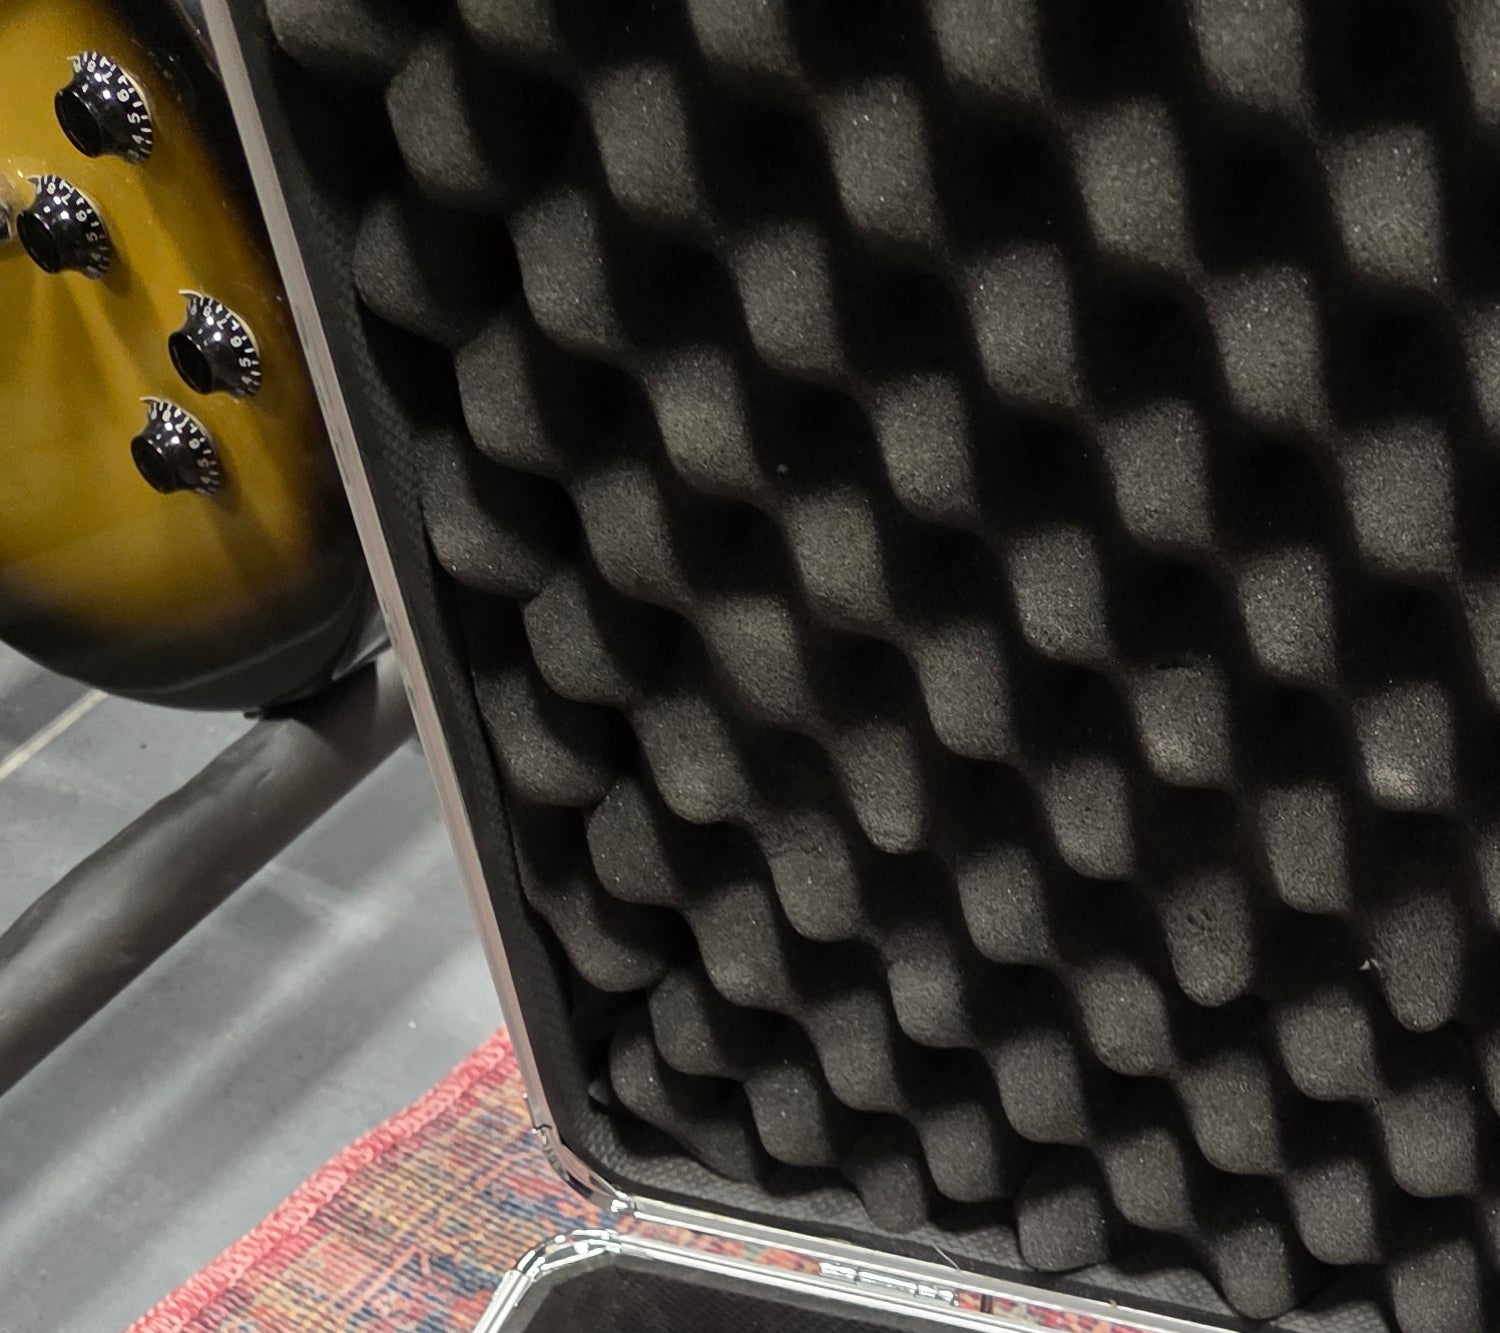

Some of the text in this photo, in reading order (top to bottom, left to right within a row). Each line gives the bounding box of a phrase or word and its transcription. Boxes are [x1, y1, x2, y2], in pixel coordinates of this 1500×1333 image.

[117, 89, 130, 102] 6
[127, 112, 141, 124] 5
[76, 210, 88, 222] 6
[85, 232, 98, 242] 5
[230, 336, 243, 348] 6
[239, 358, 252, 368] 5
